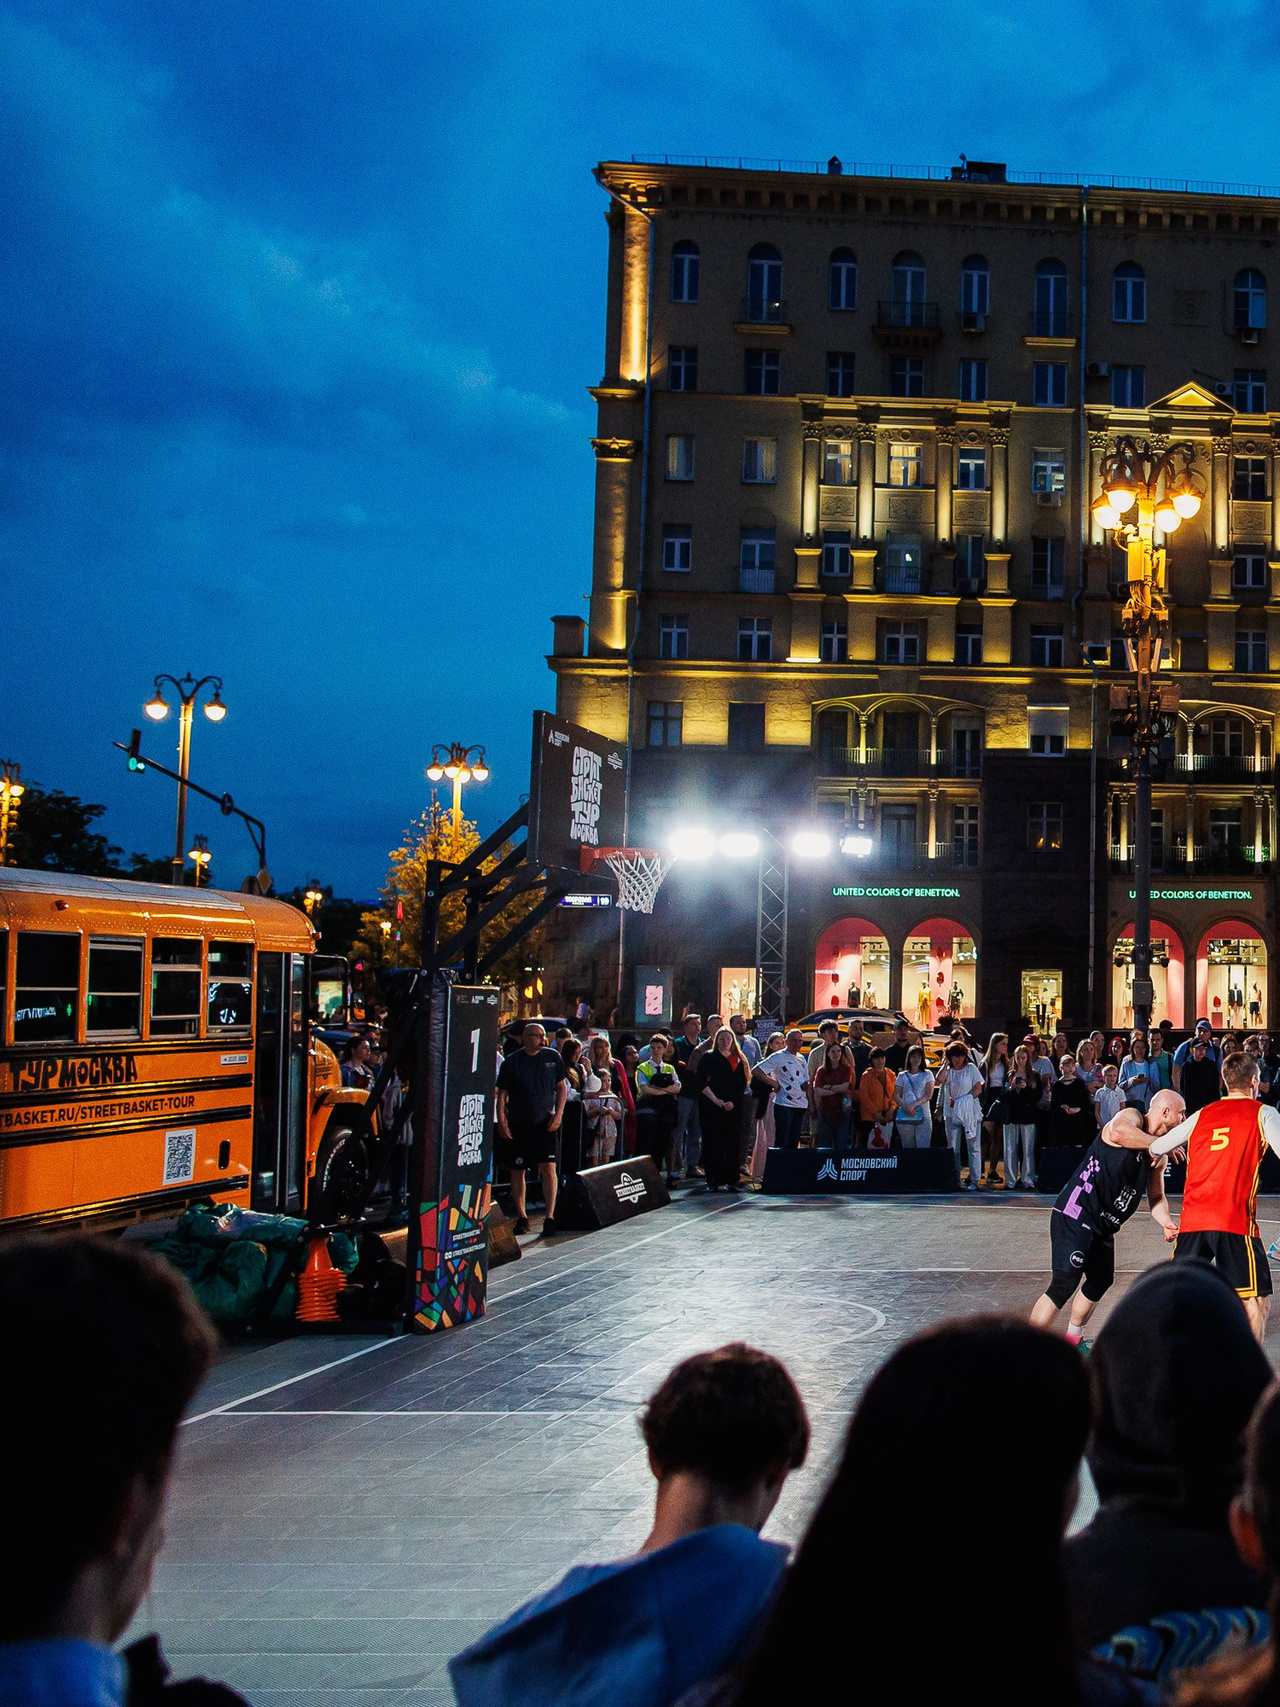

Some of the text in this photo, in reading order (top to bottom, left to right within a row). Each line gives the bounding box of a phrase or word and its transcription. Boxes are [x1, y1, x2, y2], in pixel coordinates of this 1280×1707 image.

[572, 746, 602, 782] СТРИТ
[571, 776, 602, 805] БАСКЕТ
[571, 800, 600, 828] ТУР
[570, 819, 599, 845] МОСКВА
[832, 887, 864, 897] UNITED
[865, 888, 901, 897] COLORS
[901, 888, 914, 897] OF
[1161, 890, 1194, 899] COLORS
[1195, 890, 1208, 899] OF
[471, 1028, 480, 1073] 1
[8, 1055, 138, 1091] ТУР МОСКВА
[458, 1114, 485, 1138] БАСКЕТ
[458, 1131, 483, 1153] ТУР
[1210, 1127, 1230, 1151] 5
[457, 1149, 482, 1167] МОСКВА
[841, 1156, 898, 1169] МОСКОВСКИЙ
[840, 1170, 867, 1181] СПОРТ
